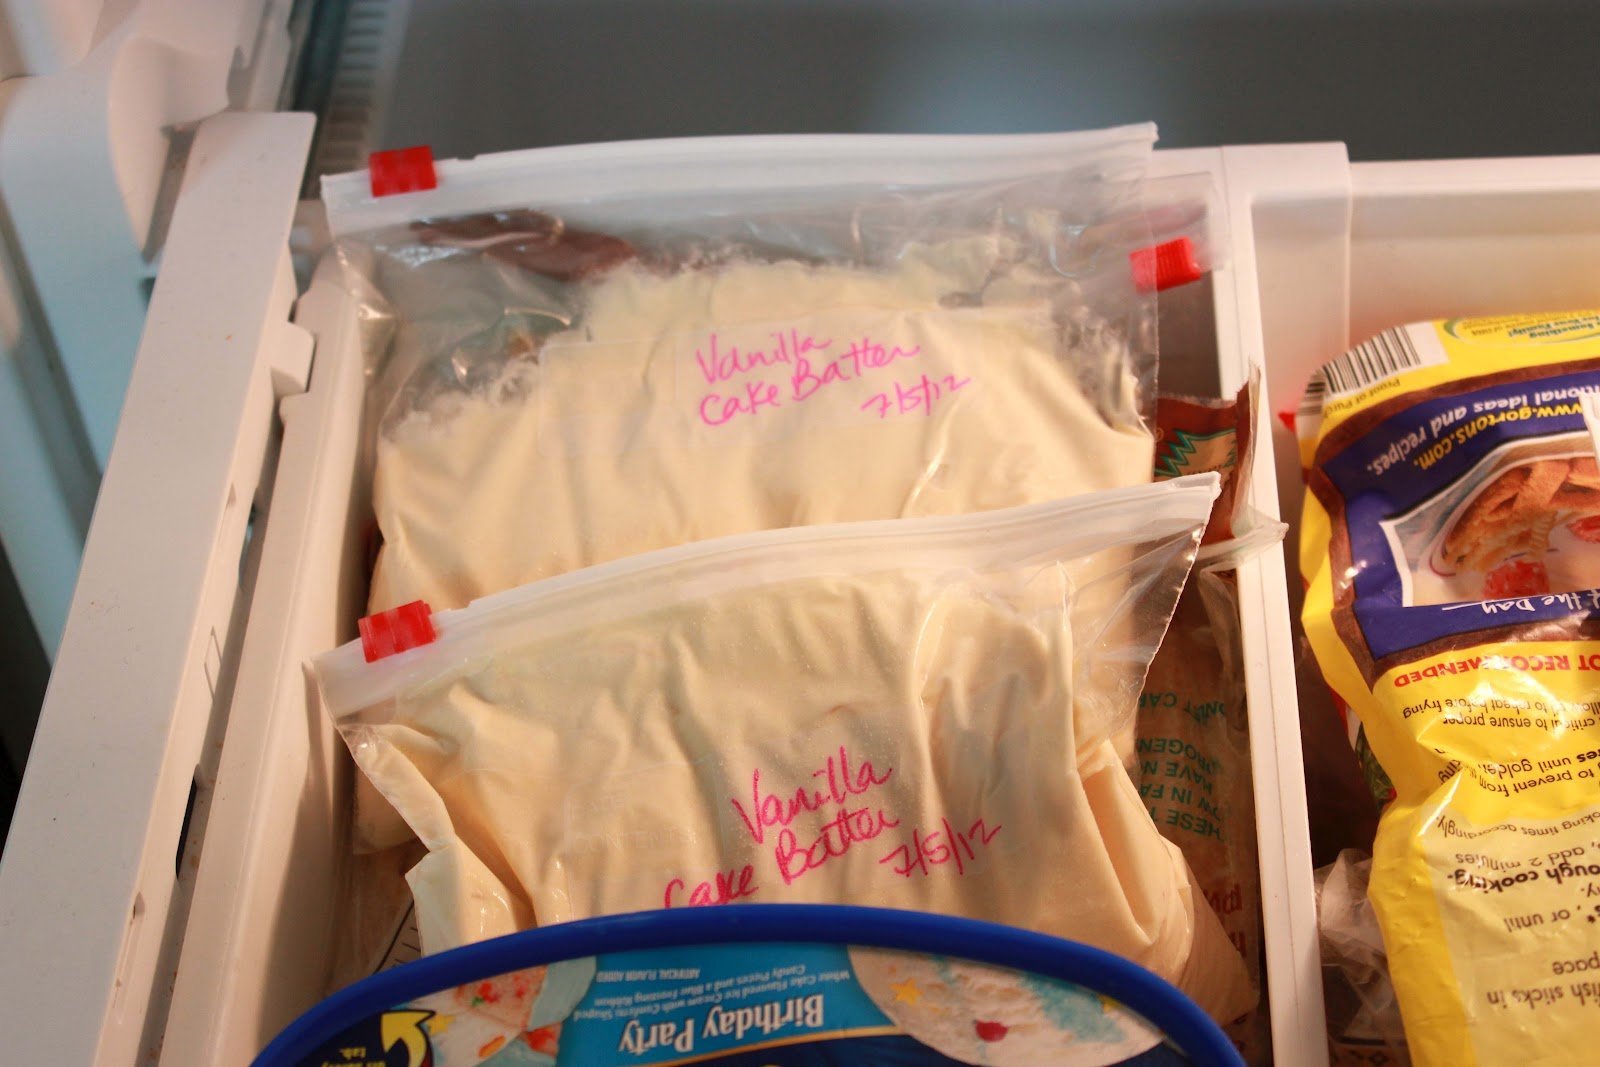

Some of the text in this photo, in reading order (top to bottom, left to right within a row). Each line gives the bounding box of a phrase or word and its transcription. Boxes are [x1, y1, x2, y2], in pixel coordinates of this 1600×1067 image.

[696, 327, 833, 385] Vanilla
[1429, 407, 1467, 433] and
[1367, 425, 1427, 478] recipes.
[1481, 597, 1532, 615] Day
[1540, 593, 1581, 610] the
[1402, 699, 1442, 719] frying
[1489, 717, 1531, 729] ensure
[1535, 717, 1548, 731] to
[1538, 757, 1571, 773] until
[1578, 768, 1594, 779] to
[1479, 774, 1510, 798] from
[1513, 771, 1572, 794] prevent
[732, 745, 893, 845] Vanilla
[1521, 825, 1559, 837] times
[775, 807, 900, 886] Batter
[879, 816, 1002, 878] 7/5/12
[1547, 846, 1585, 865] add
[1528, 856, 1543, 867] 2
[1503, 913, 1544, 933] until
[1551, 908, 1571, 923] or
[1487, 989, 1507, 1010] in
[1512, 985, 1563, 1010] sticks
[618, 993, 824, 1056] Birthday Party
